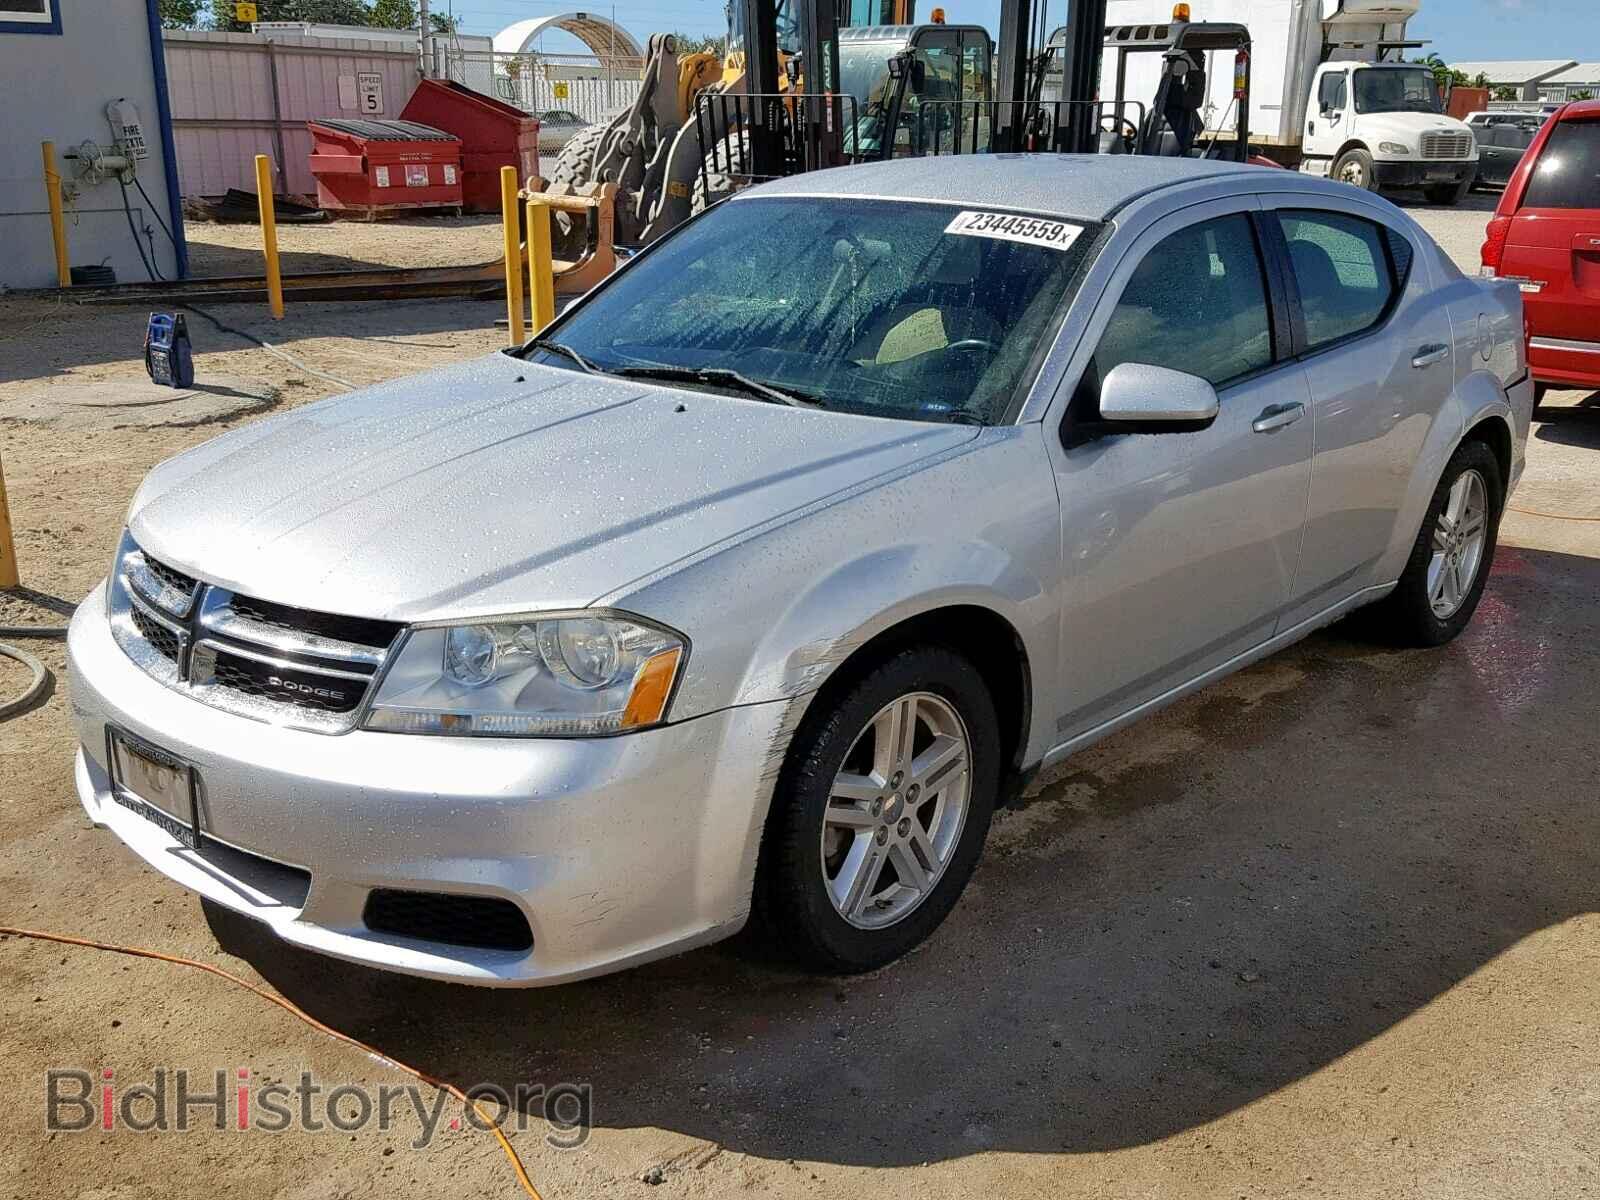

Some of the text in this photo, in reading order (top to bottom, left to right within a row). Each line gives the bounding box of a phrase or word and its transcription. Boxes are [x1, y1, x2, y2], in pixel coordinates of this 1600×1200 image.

[359, 76, 380, 84] SPEED
[367, 94, 377, 110] 5
[122, 124, 140, 137] FIRE
[268, 676, 345, 700] DODGE
